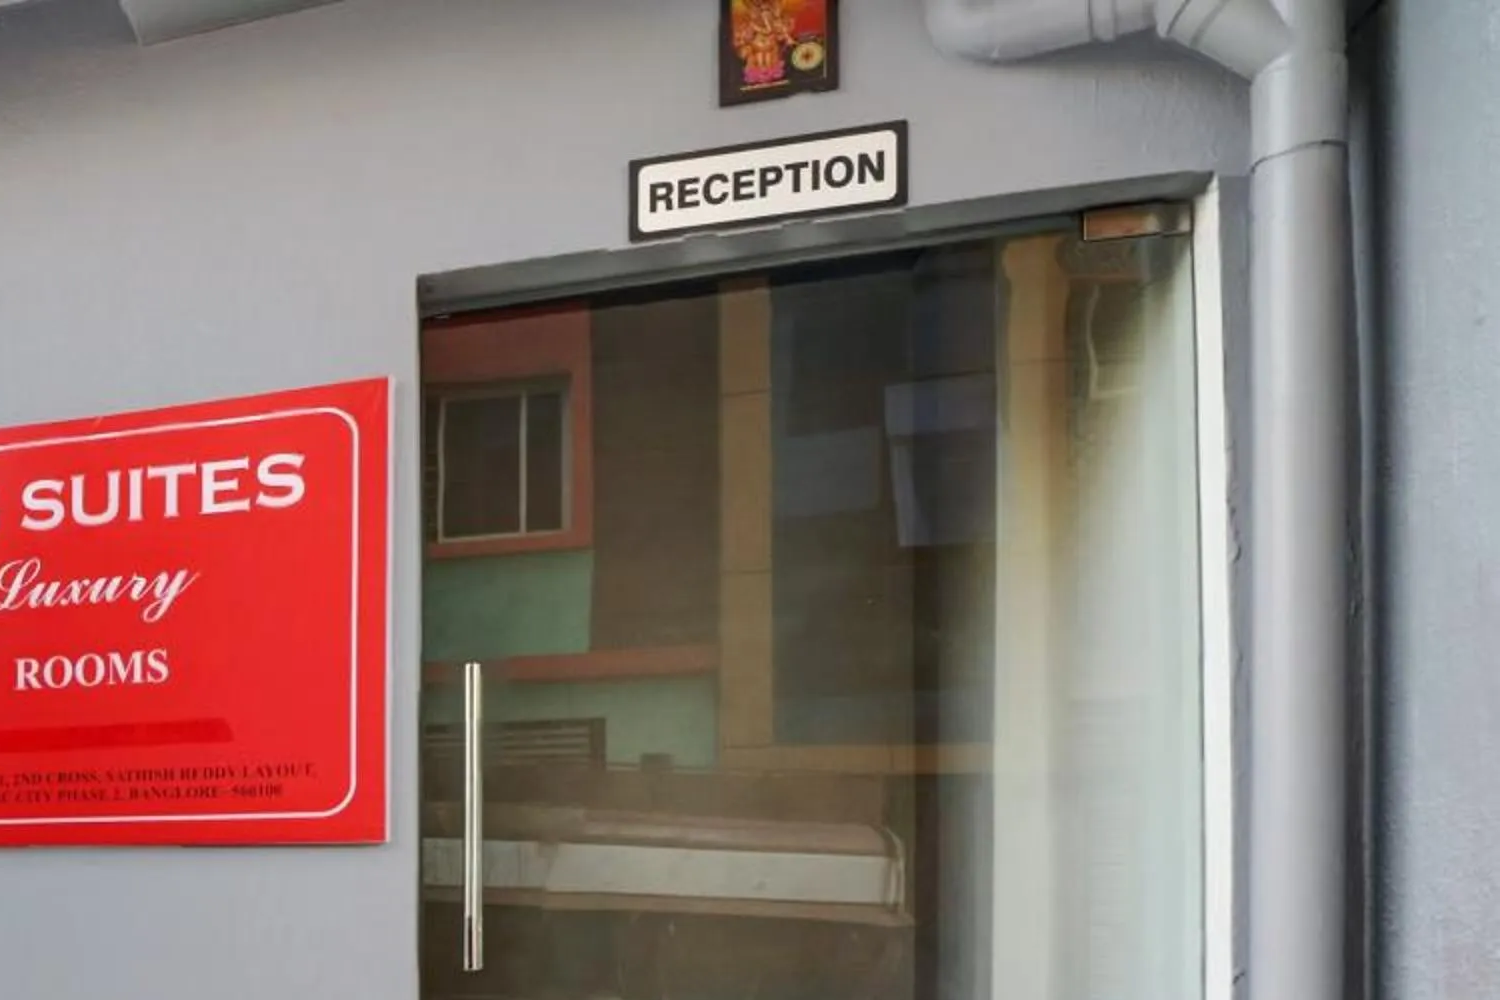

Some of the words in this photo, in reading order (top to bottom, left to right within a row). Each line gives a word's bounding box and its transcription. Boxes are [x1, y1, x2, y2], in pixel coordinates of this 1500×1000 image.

[648, 150, 886, 213] RECEPTION
[21, 452, 306, 531] SUITES
[14, 648, 169, 690] ROOMS
[14, 789, 53, 803] CITY
